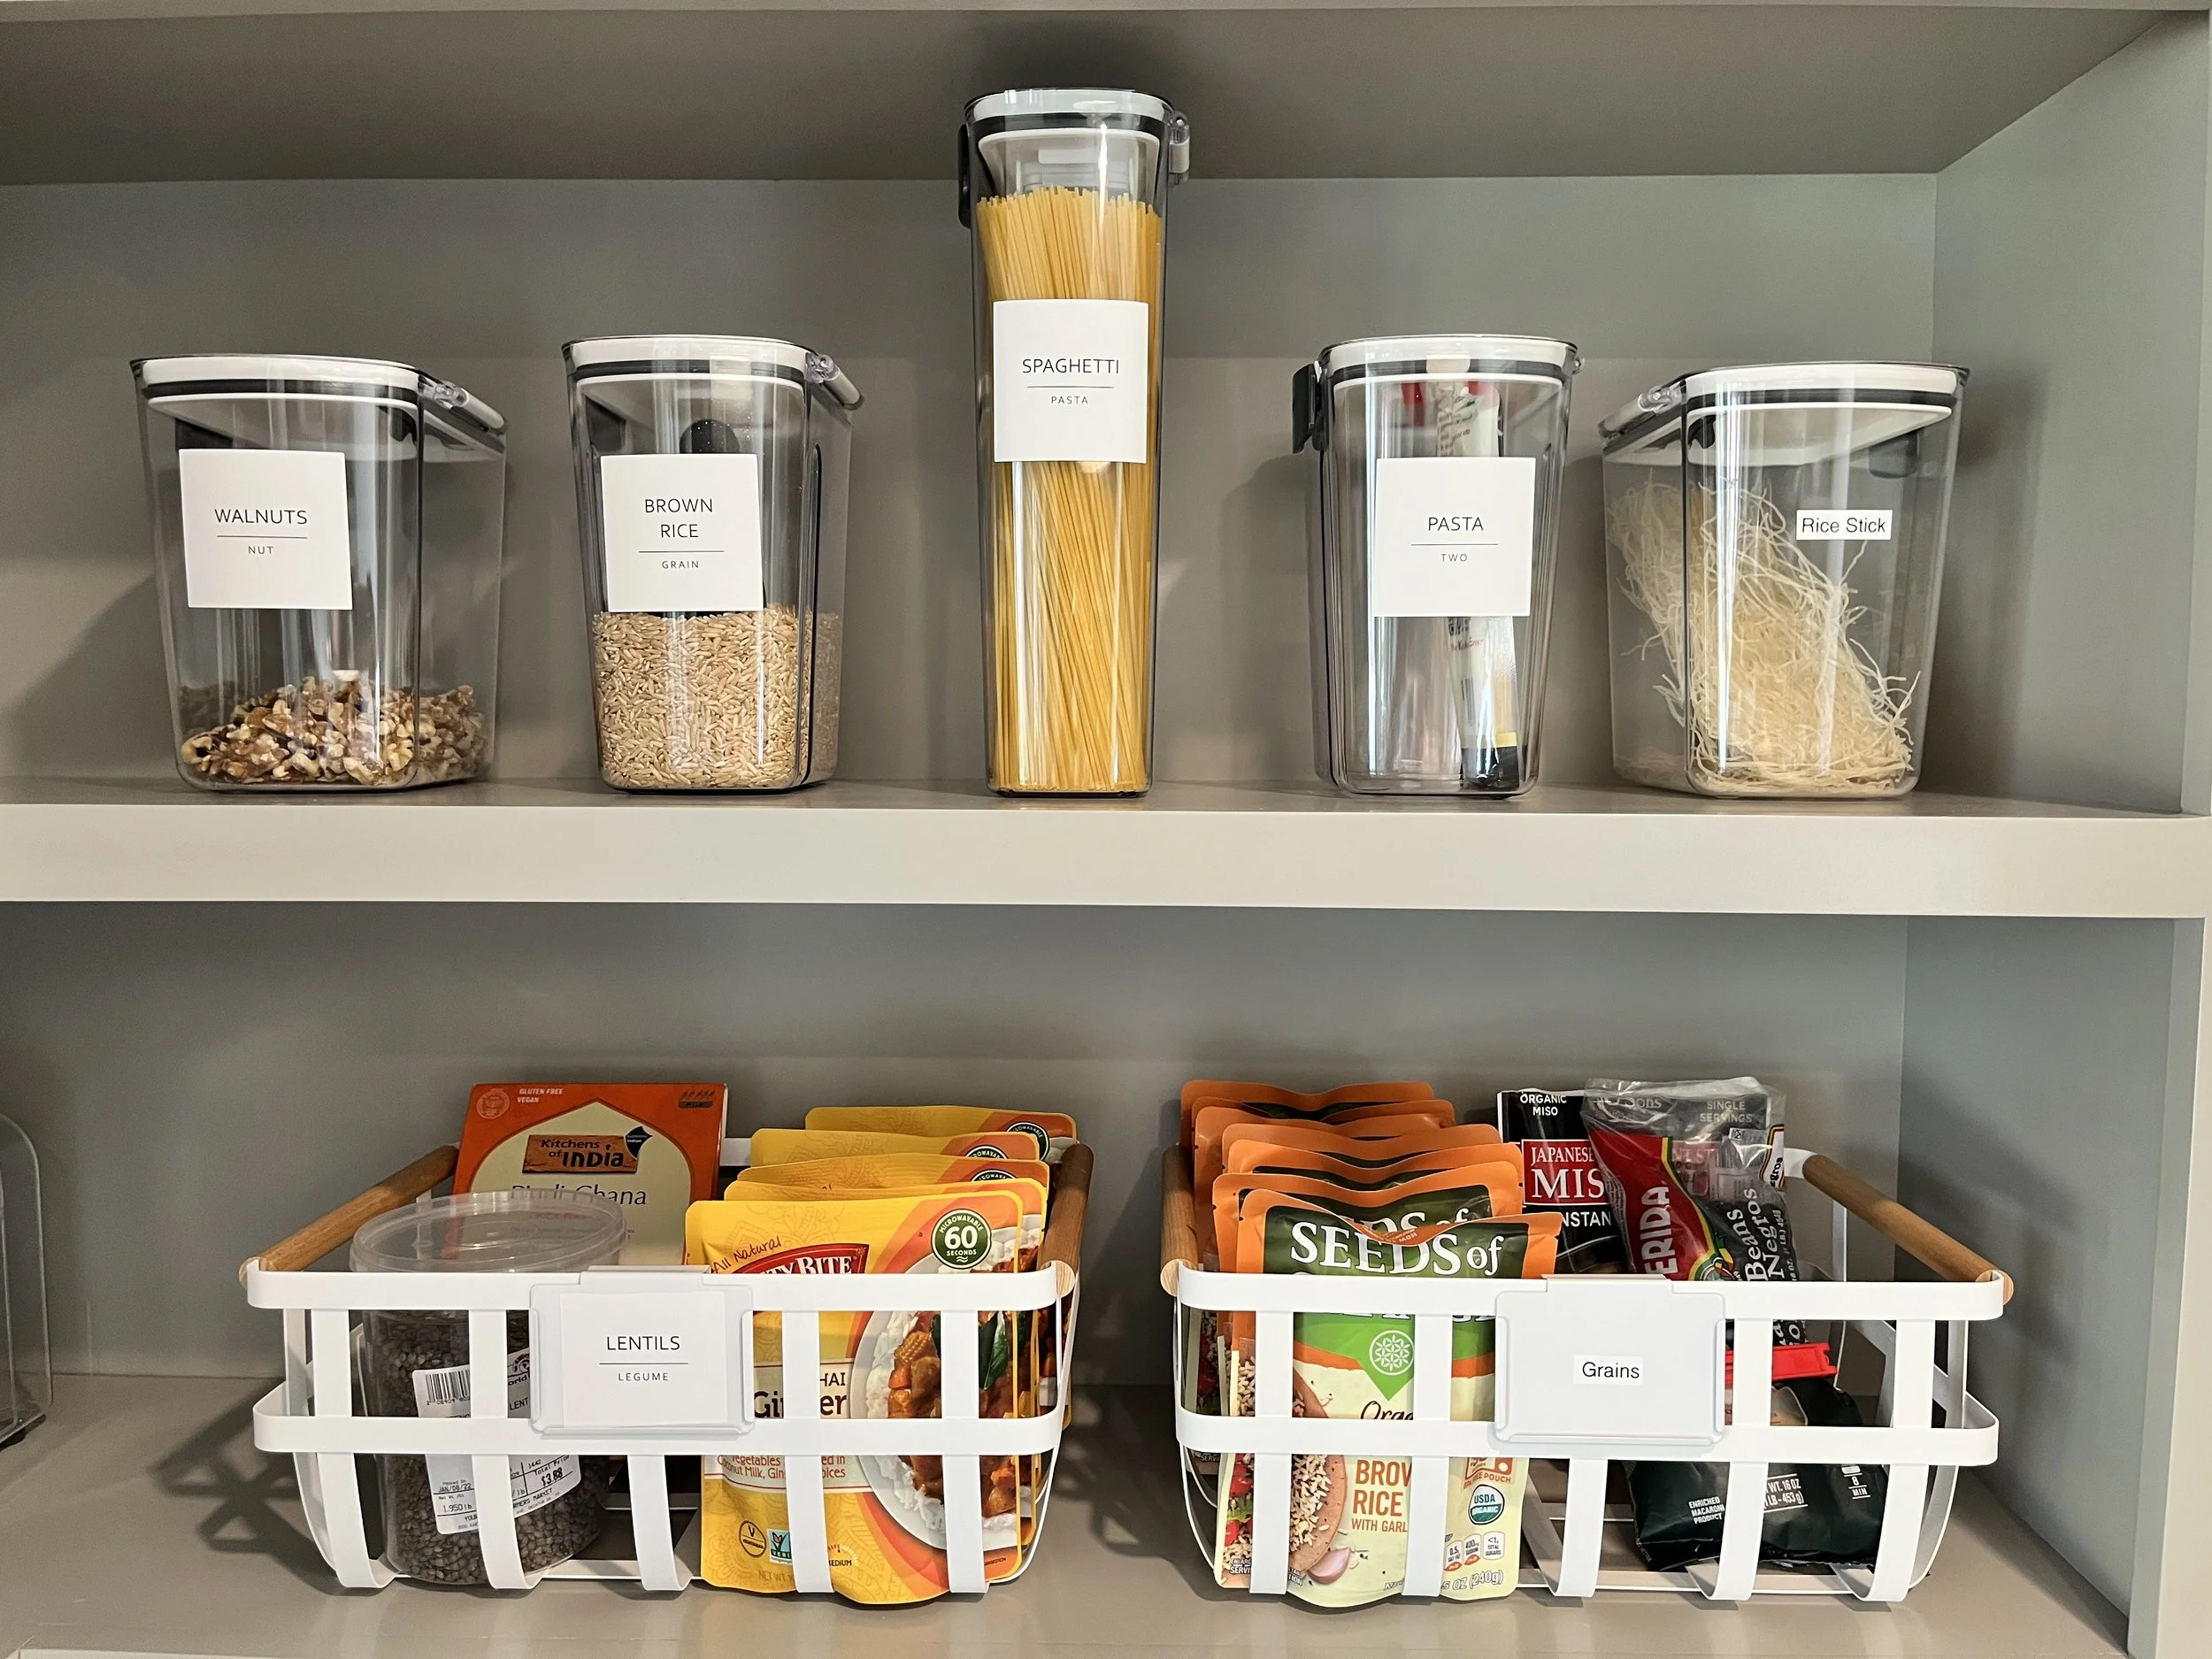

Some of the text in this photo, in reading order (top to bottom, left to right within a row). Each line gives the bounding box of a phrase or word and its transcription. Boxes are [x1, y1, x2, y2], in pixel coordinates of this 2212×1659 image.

[1021, 358, 1120, 375] SPAGHETTI
[1050, 396, 1089, 404] PASTA
[644, 498, 713, 513] BROWN
[214, 508, 308, 525] WALNUTS
[660, 524, 699, 538] RICE
[1427, 516, 1484, 532] PASTA
[1801, 517, 1886, 534] Rice Stick
[248, 545, 273, 555] NUT
[661, 560, 700, 570] GRAIN
[1440, 553, 1468, 563] TWO
[1519, 1093, 1567, 1104] ORGANIC
[1707, 1100, 1746, 1110] SINGLE
[1532, 1105, 1559, 1117] MISO
[1699, 1112, 1753, 1123] SERVINGS
[540, 1138, 600, 1149] Kitchens
[548, 1148, 562, 1158] of
[1531, 1167, 1605, 1199] MIS
[938, 1215, 984, 1233] MICROWAVABLE
[1562, 1210, 1612, 1227] NSTAN
[944, 1225, 979, 1250] 60
[1639, 1186, 1678, 1275] ERIDA
[1743, 1187, 1786, 1279] Negros
[1290, 1219, 1463, 1276] SEEDS
[1465, 1235, 1505, 1277] of
[1726, 1209, 1770, 1282] Beans
[712, 1235, 782, 1273] All Natural
[606, 1335, 680, 1350] LENTILS
[618, 1372, 669, 1381] LEGUME
[1582, 1361, 1640, 1379] Grains
[507, 1374, 528, 1386] orld
[819, 1372, 846, 1386] HAI
[509, 1397, 529, 1411] LENT
[534, 1463, 551, 1476] Total
[744, 1467, 765, 1479] Milk,
[1484, 1471, 1511, 1484] POUCH
[1851, 1476, 1860, 1486] 8
[1768, 1478, 1801, 1494] WT. 16 OZ
[1852, 1487, 1868, 1497] MIN
[533, 1487, 553, 1502] MARKET
[1473, 1494, 1496, 1504] USDA
[1782, 1492, 1796, 1504] 453
[1352, 1489, 1404, 1517] RICE
[1688, 1496, 1721, 1509] ENRICHED
[1471, 1505, 1499, 1517] ORGANIC
[1691, 1503, 1725, 1517] MACARONI
[1351, 1517, 1409, 1533] WITH GARL
[1694, 1513, 1723, 1525] PRODUCT
[772, 1549, 791, 1558] VERI
[1231, 1566, 1252, 1575] SERVI
[1452, 1576, 1468, 1591] OZ
[1469, 1569, 1504, 1590] (240g)
